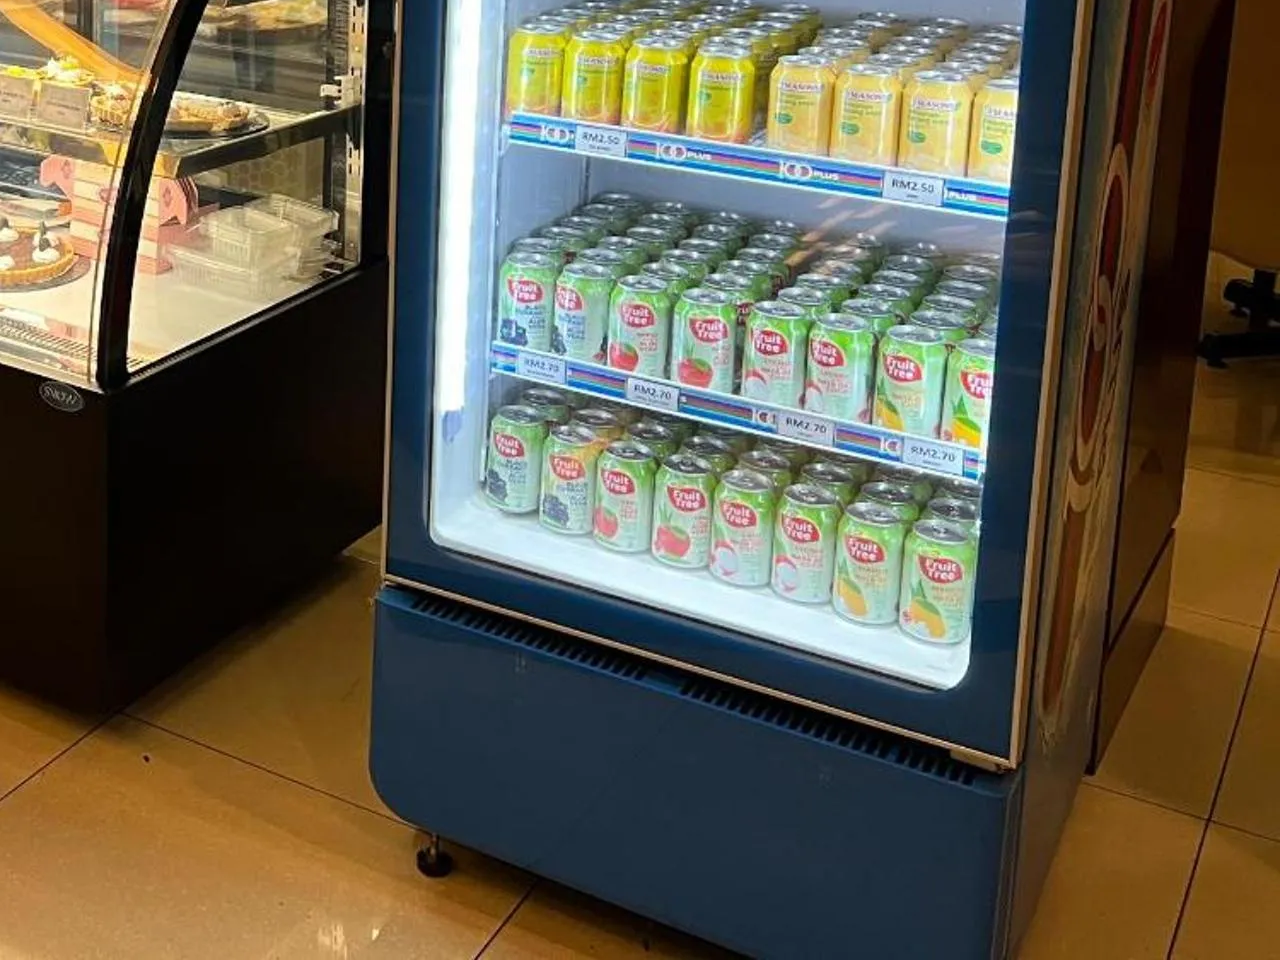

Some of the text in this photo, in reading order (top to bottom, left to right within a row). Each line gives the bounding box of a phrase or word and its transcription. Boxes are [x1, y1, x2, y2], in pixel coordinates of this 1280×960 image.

[753, 329, 783, 346] Fruit
[754, 339, 781, 354] Tree
[886, 355, 915, 371] Fruit
[888, 367, 915, 381] Tree
[633, 384, 672, 401] RM2.70
[494, 434, 520, 450] Fruit
[496, 442, 519, 456] Tree
[552, 456, 579, 470] Fruit
[556, 466, 579, 478] Tree
[603, 471, 630, 486] Fruit
[605, 479, 629, 494] Tree
[672, 488, 702, 502] Fruit
[675, 498, 700, 510] Tree
[722, 502, 752, 518] Fruit
[724, 512, 751, 525] Tree
[782, 516, 814, 534] Fruit
[785, 526, 812, 541] Tree
[847, 537, 878, 554] Fruit
[848, 547, 878, 563] Tree
[924, 559, 957, 576] Fruit
[926, 569, 956, 582] Tree
